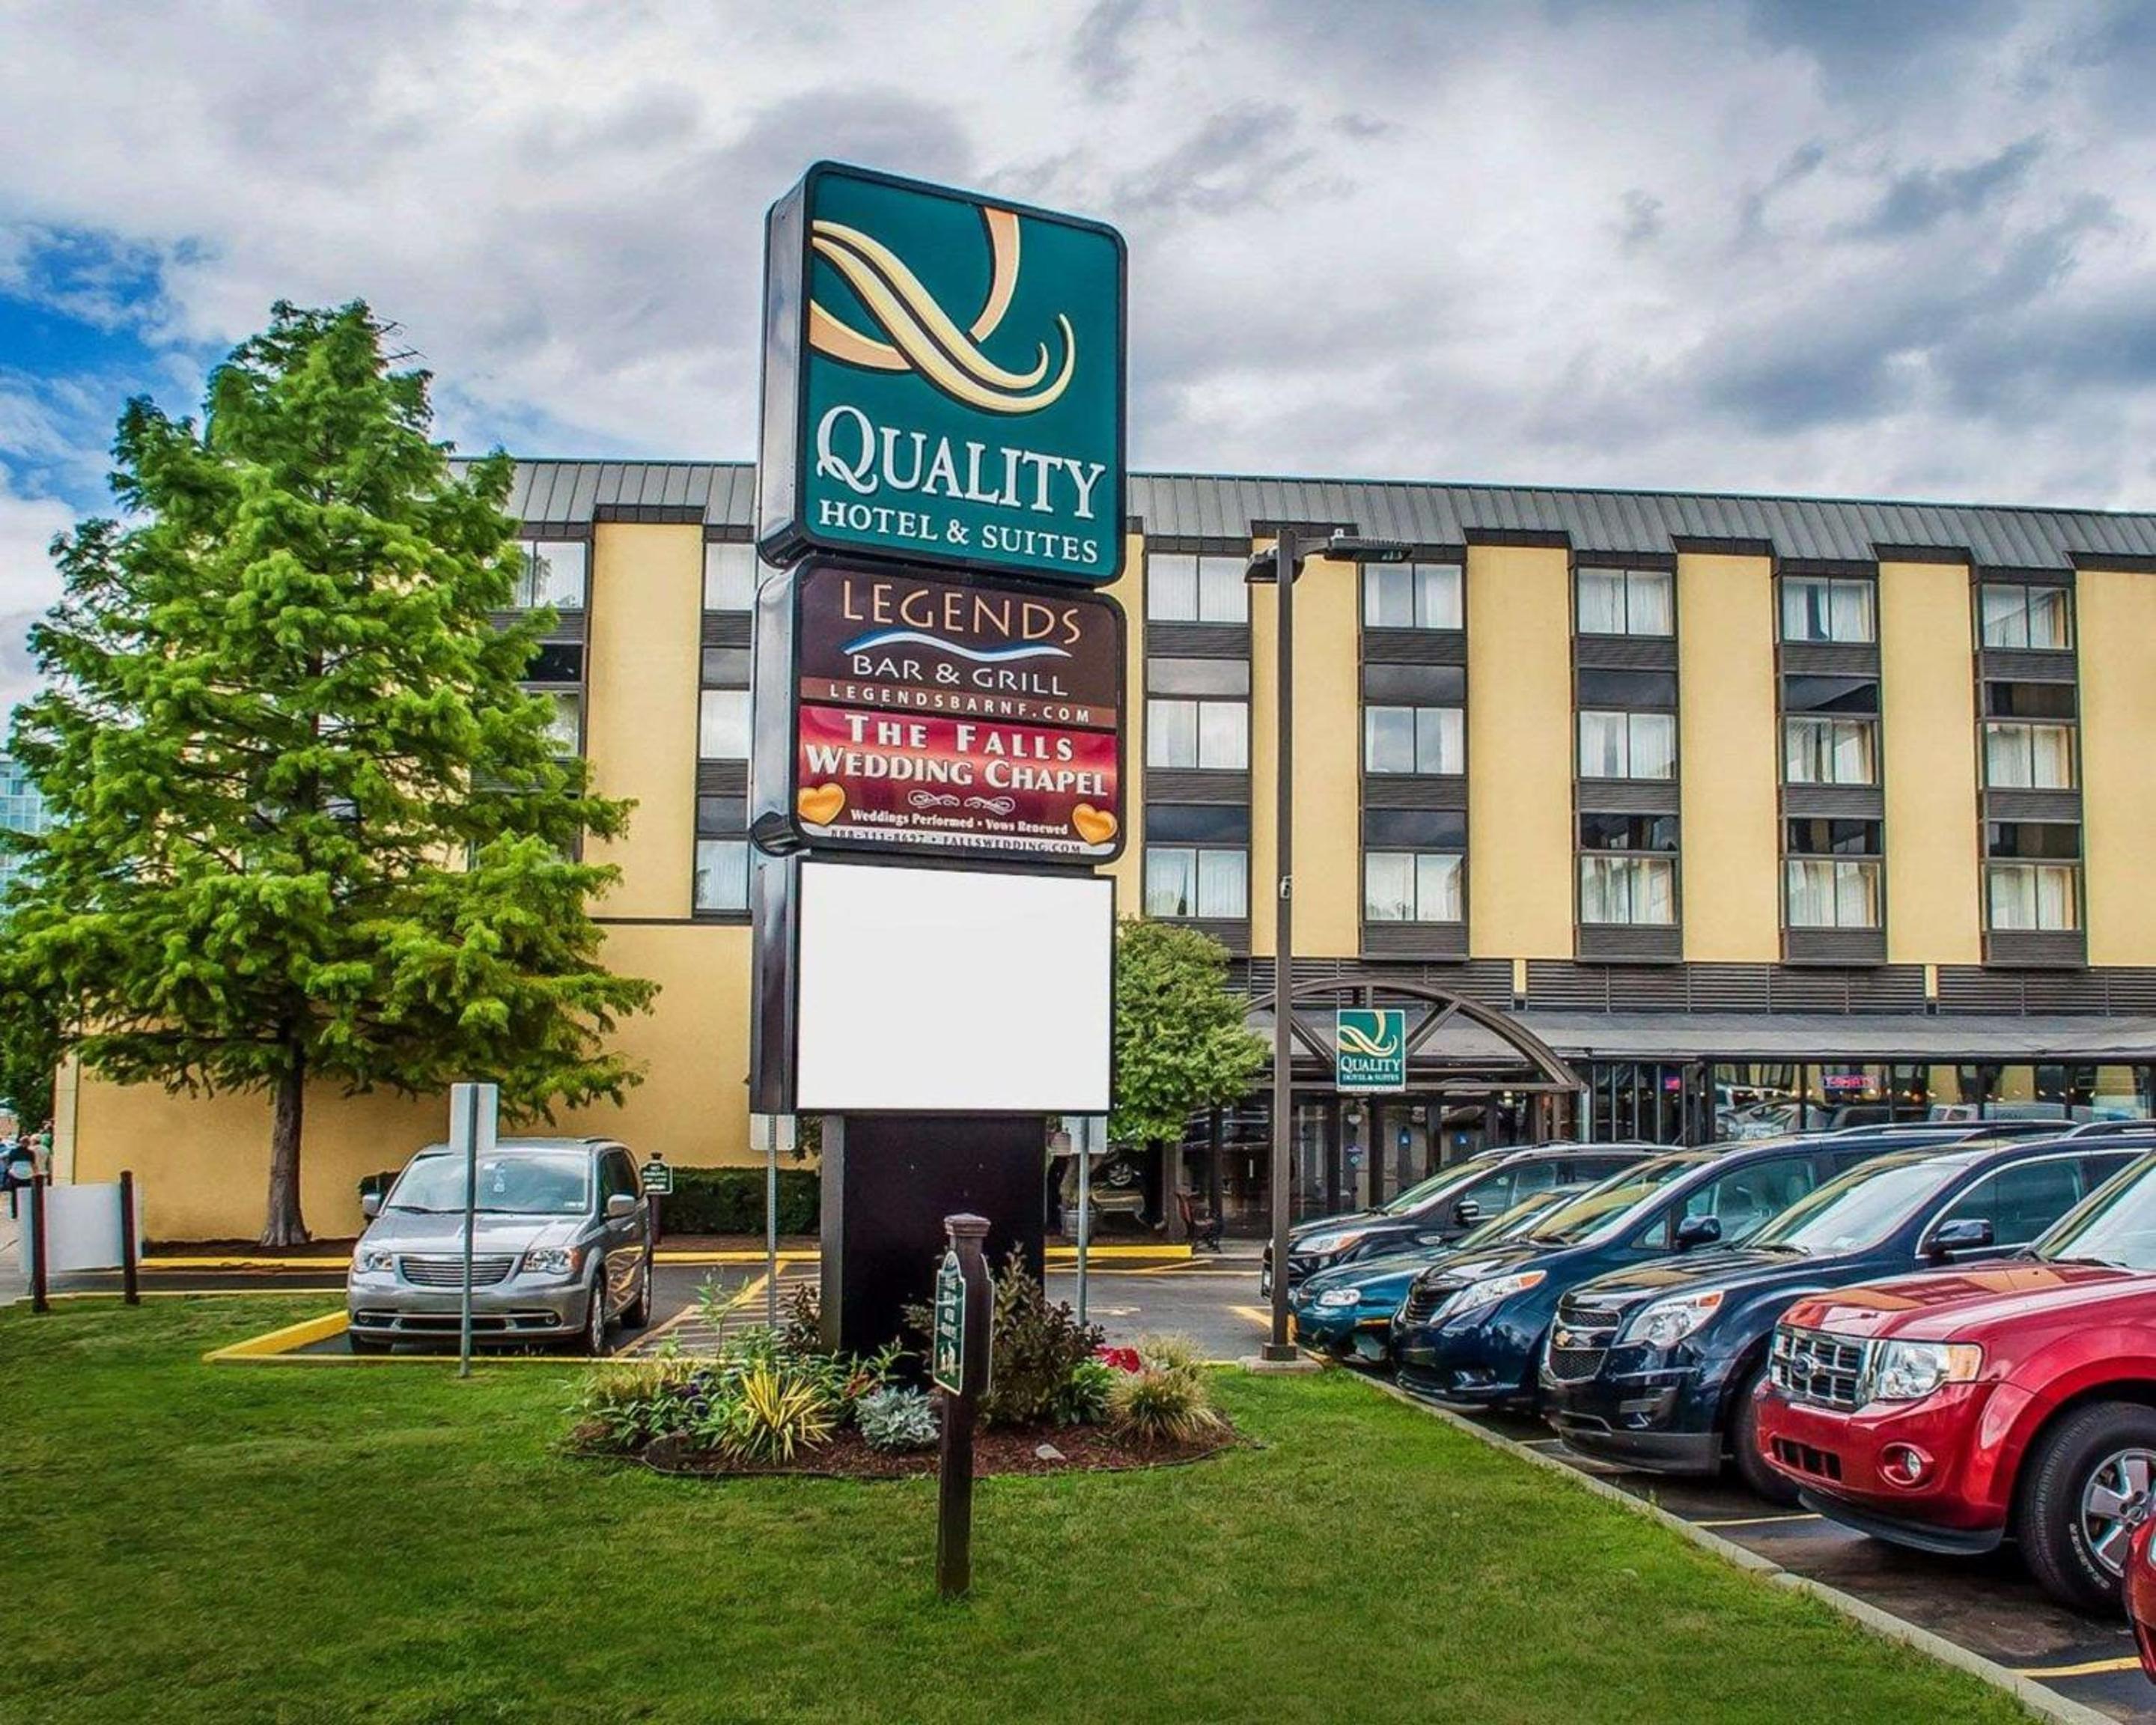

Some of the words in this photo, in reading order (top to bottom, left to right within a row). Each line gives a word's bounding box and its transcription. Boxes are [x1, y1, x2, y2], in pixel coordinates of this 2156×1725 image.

[817, 404, 1106, 520] QUALITY
[819, 499, 938, 541] HOTEL
[947, 518, 969, 545] &
[982, 524, 1098, 565] SUITES
[843, 579, 1082, 645] LEGENDS
[853, 655, 922, 681] BAR
[936, 663, 960, 685] &
[972, 668, 1068, 696] GRILL
[829, 684, 1090, 722] LEGENDSBARNF.COM
[844, 714, 927, 749] THE
[956, 723, 1073, 761] FALLS
[805, 743, 973, 785] WEDDING
[984, 759, 1108, 797] CHAPEL
[850, 809, 909, 827] Weddings
[912, 813, 973, 829] Performed
[985, 819, 1015, 832] Vows
[1017, 821, 1068, 835] Renewed
[1341, 1056, 1401, 1074] QUALITY
